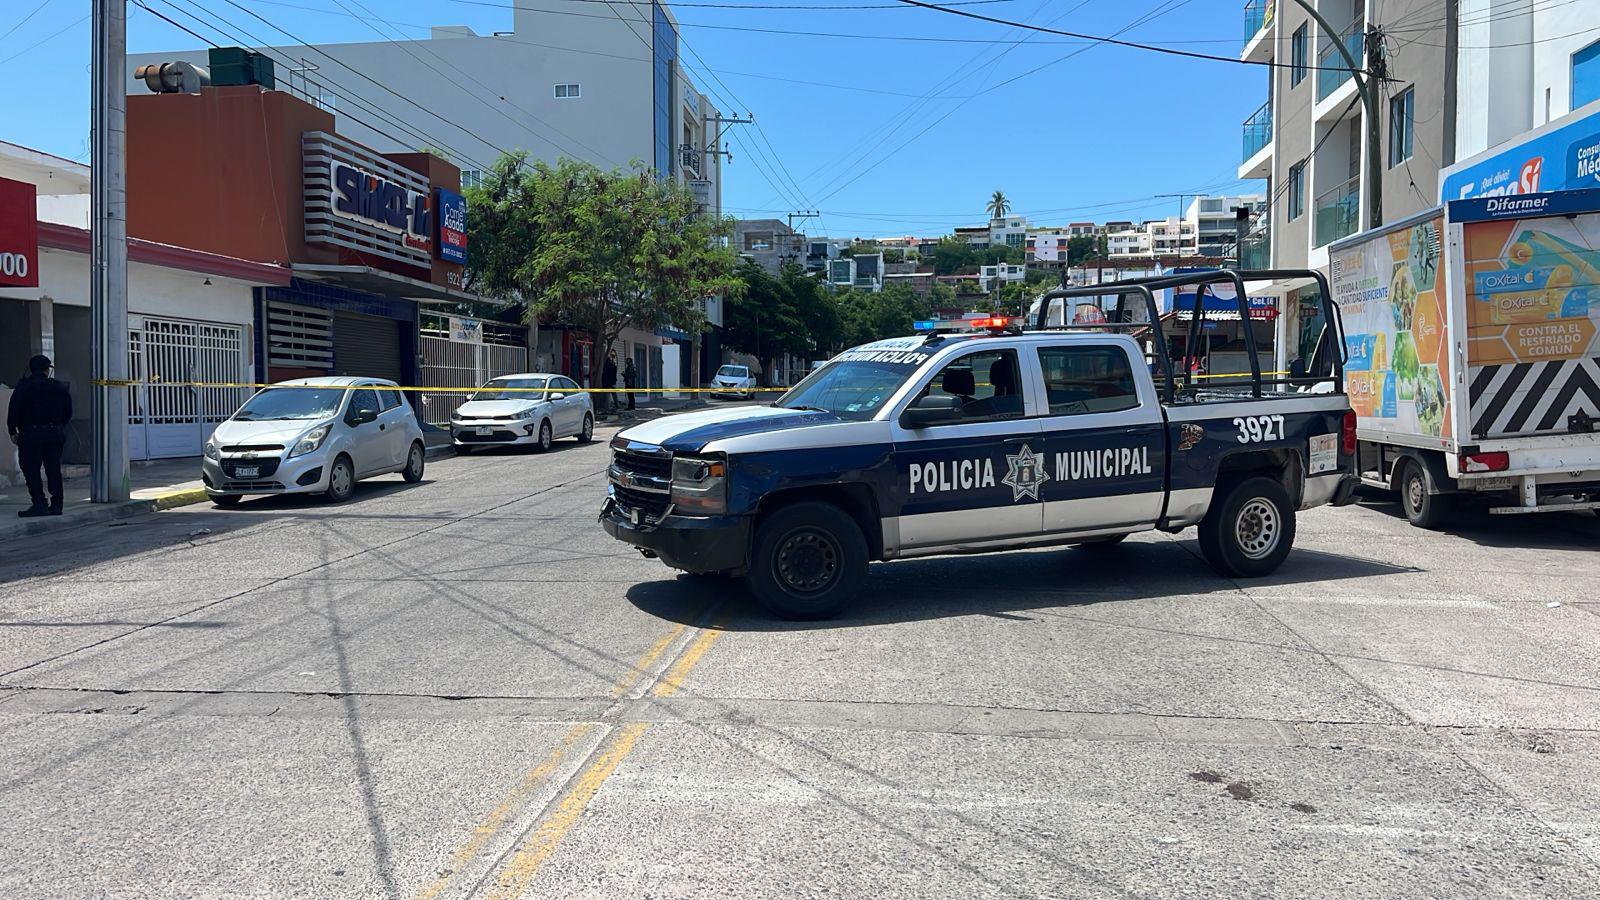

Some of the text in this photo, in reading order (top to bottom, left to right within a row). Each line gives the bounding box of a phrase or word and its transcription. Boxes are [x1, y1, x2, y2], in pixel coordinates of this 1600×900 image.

[444, 214, 464, 233] Asada
[0, 250, 28, 278] 00
[447, 271, 460, 285] 1922
[1362, 286, 1388, 301] SUFICIENTE
[1251, 309, 1274, 317] SUSHI
[1519, 323, 1581, 338] CONTRA EL
[1519, 333, 1582, 347] RESFRIADO
[1233, 415, 1285, 444] 3927
[909, 446, 1152, 493] POLICIA MUNICIPAL
